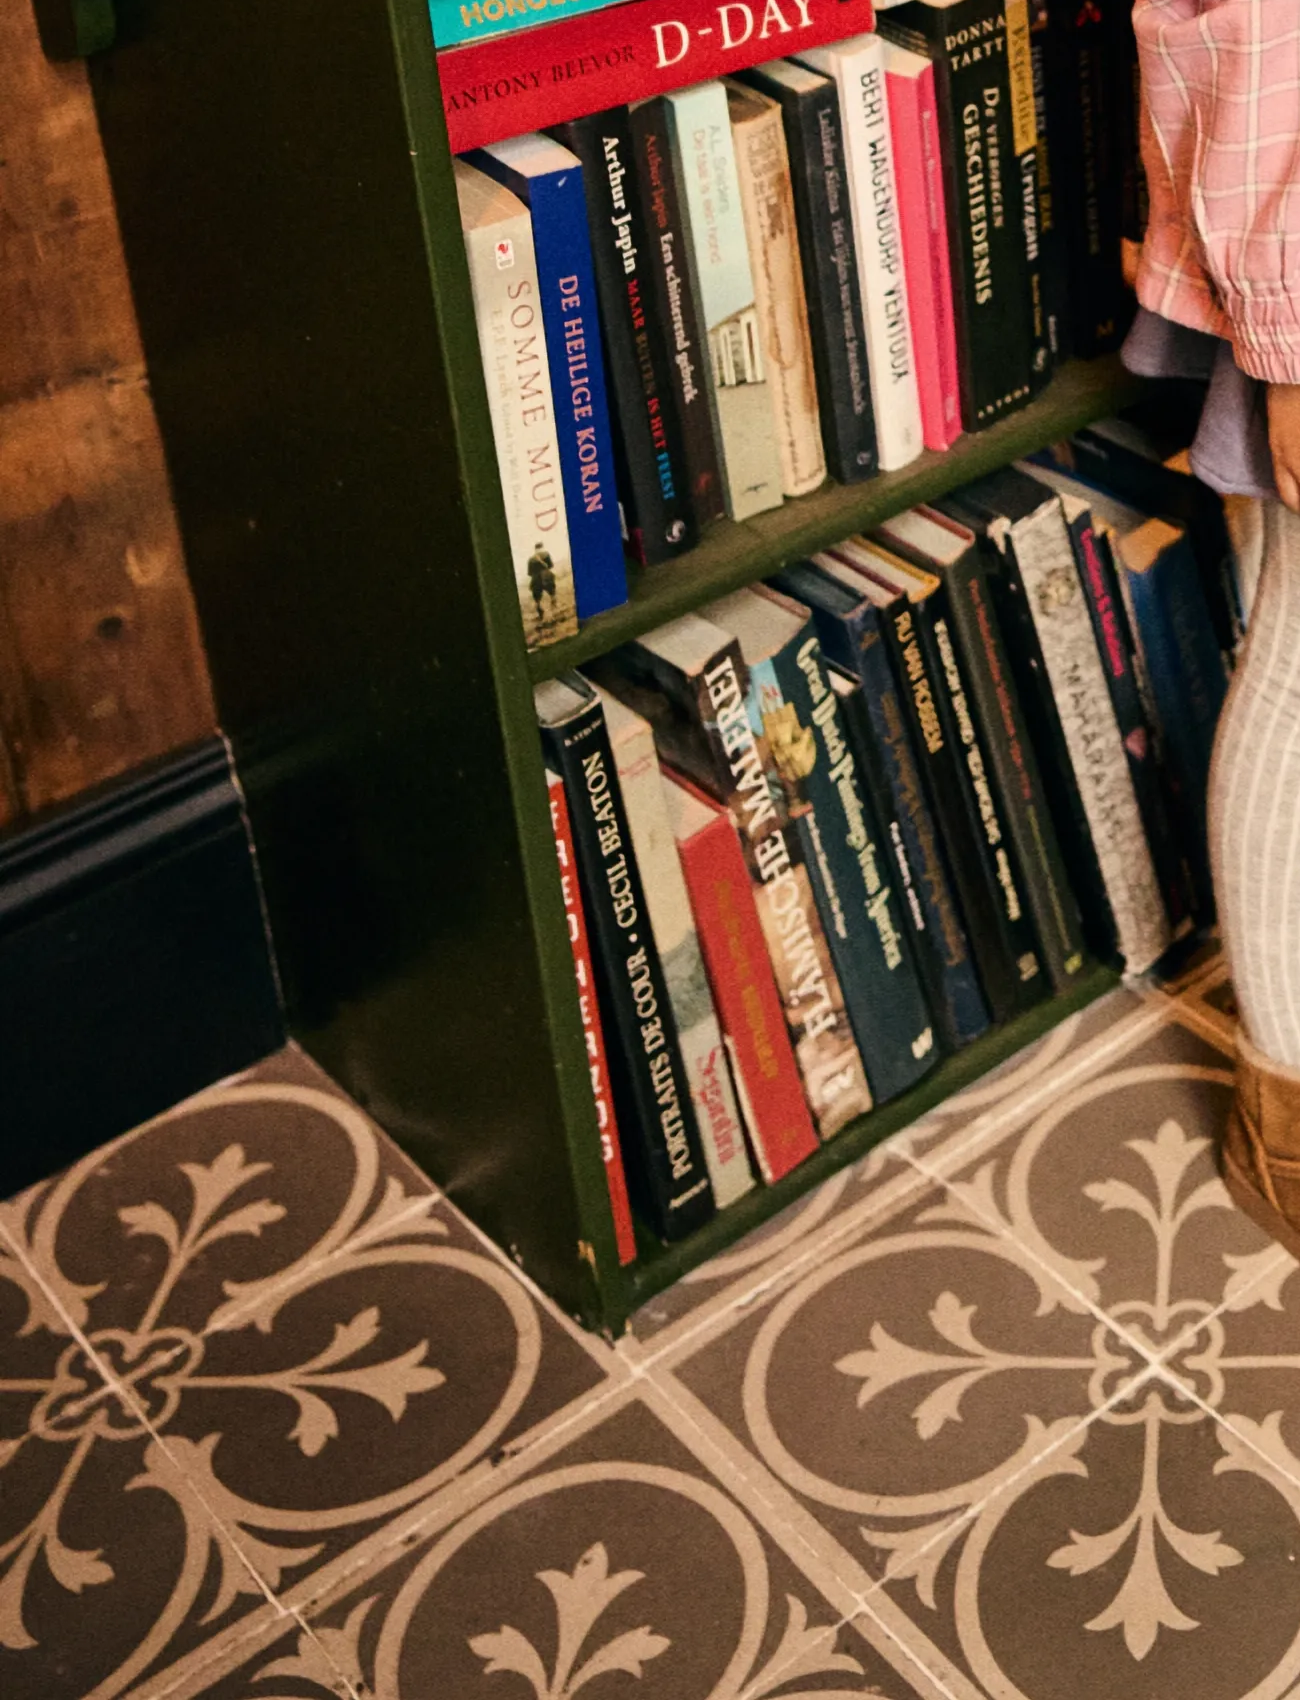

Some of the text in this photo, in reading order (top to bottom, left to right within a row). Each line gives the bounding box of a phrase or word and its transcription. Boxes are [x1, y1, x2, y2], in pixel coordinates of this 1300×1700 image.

[446, 41, 637, 112] ANTONY BEEVOR
[945, 14, 1006, 51] DONNA
[951, 35, 1005, 72] TARTT
[598, 135, 640, 273] Arthur Japin
[855, 70, 915, 384] BERT WAGENDORP VENTOUX
[960, 103, 993, 304] GESCHIEDENIS
[1018, 154, 1043, 260] Uruzgan
[504, 280, 562, 532] SOMME MUD
[557, 274, 606, 512] DE HEILIGE KORAN
[703, 656, 776, 824] MALEREI
[891, 610, 948, 753] RU VAN ROSSEM
[579, 753, 622, 851] BEATON
[795, 637, 905, 970] Great Dutch Paintings from America
[601, 852, 640, 928] CECIL
[753, 831, 840, 1043] FLÄMISCHE
[623, 948, 661, 1018] COUR
[638, 1017, 669, 1053] DE
[650, 1054, 698, 1178] PORTRAITS
